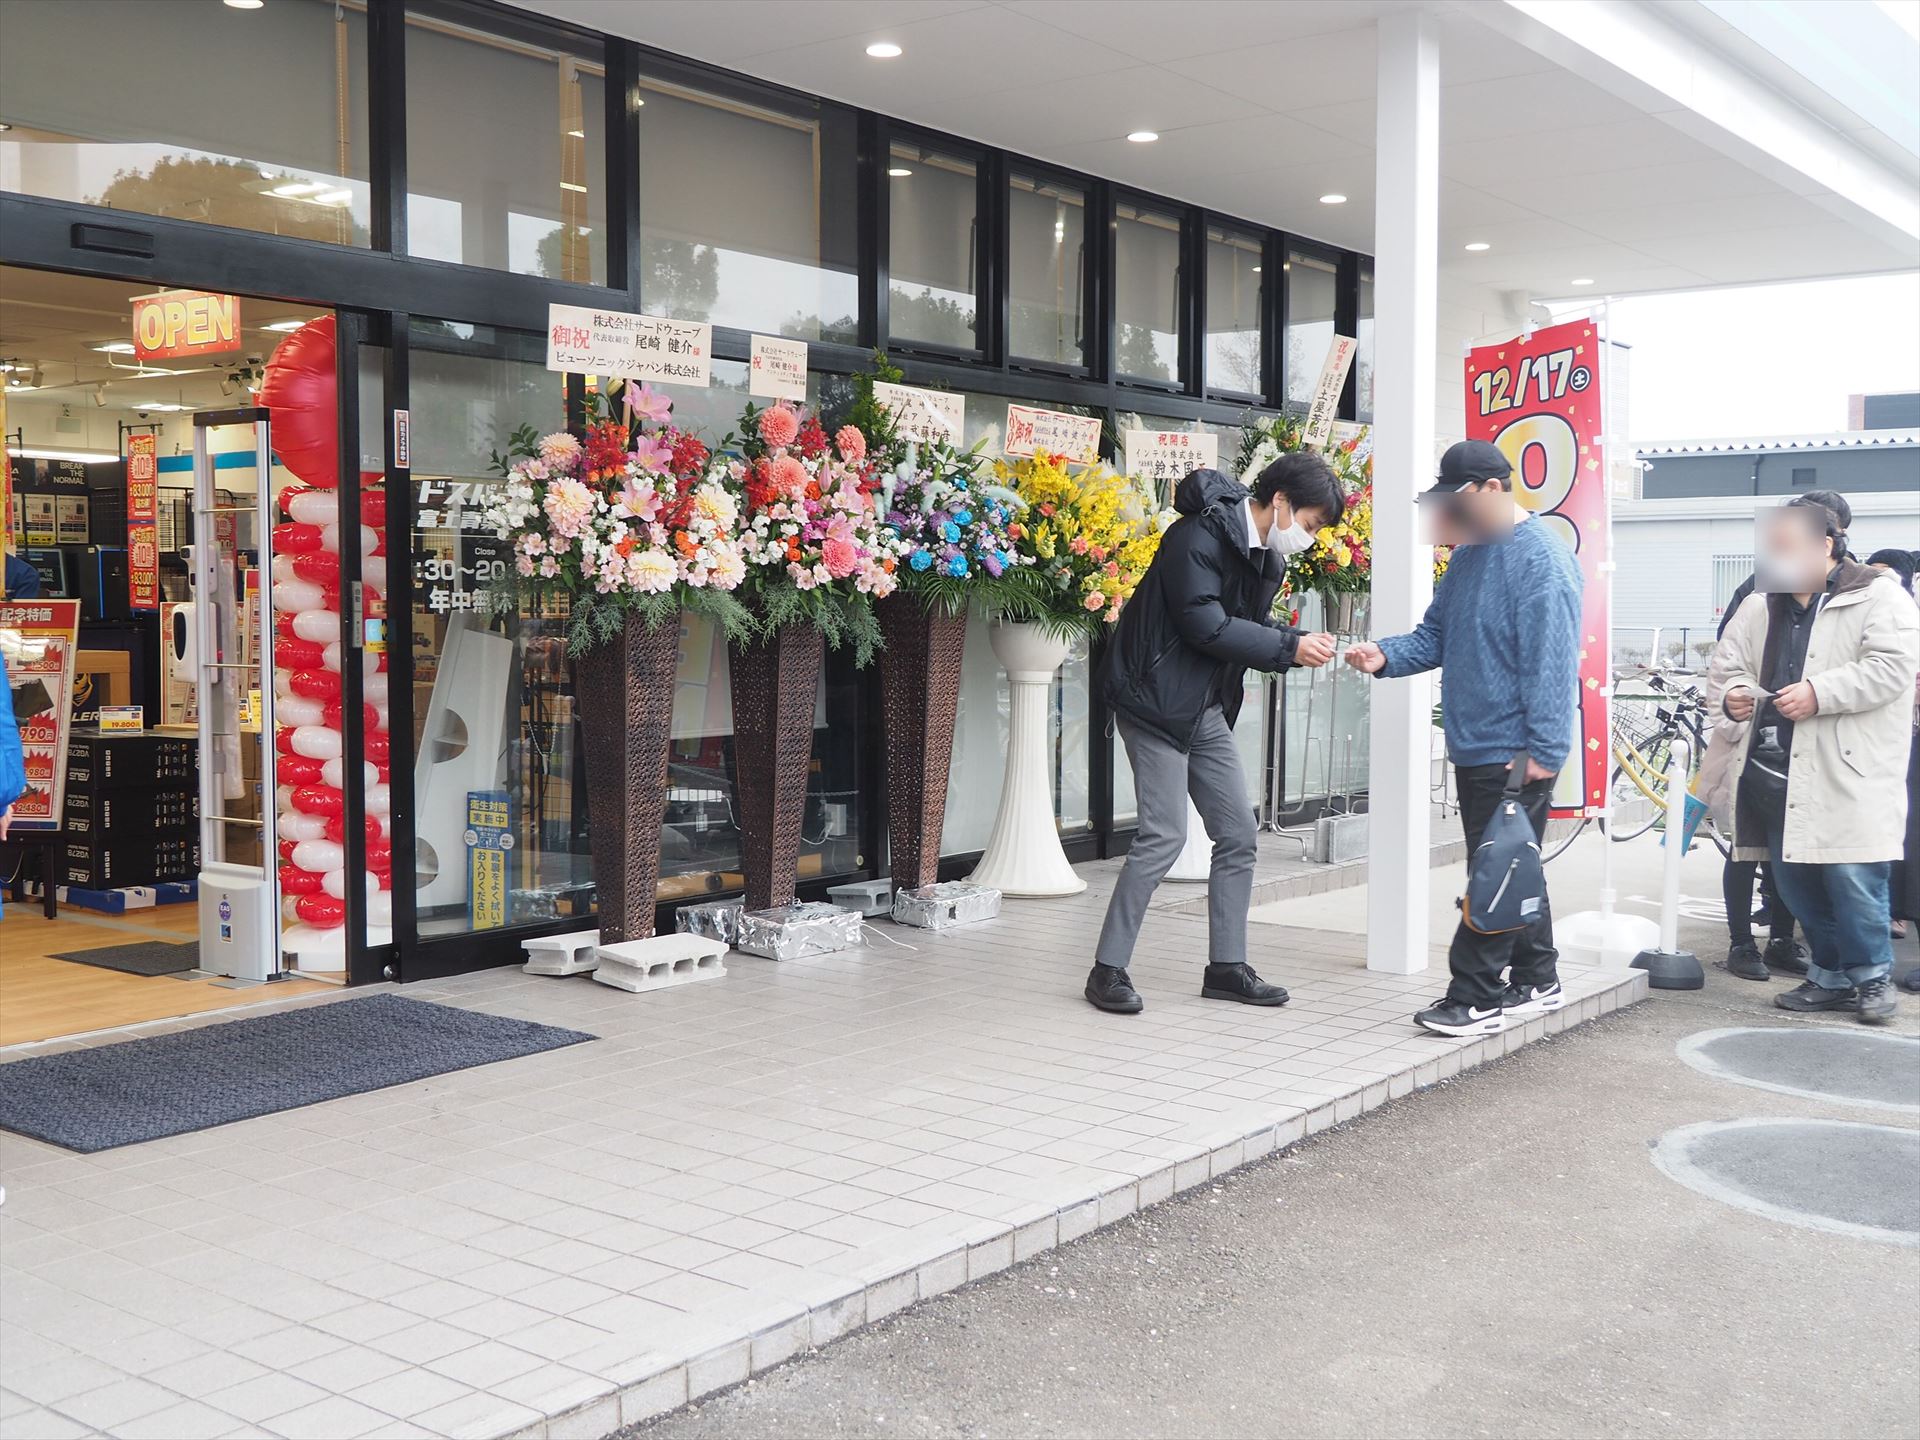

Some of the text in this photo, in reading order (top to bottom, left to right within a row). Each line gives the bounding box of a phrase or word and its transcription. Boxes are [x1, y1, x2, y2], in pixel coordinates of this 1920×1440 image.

[140, 295, 232, 350] OPEN
[594, 314, 701, 338] 株式会社サードウェーブ
[552, 324, 591, 349] 御祝
[635, 334, 661, 351] 尾崎
[556, 351, 701, 378] ビューソニックジャパン株式会社
[753, 355, 761, 369] 祝
[1473, 347, 1575, 416] 12/17
[1158, 433, 1189, 446] 祝開店
[1136, 449, 1203, 460] インテル株式会社
[60, 462, 84, 470] BREAK
[53, 477, 85, 485] NORMAL
[474, 547, 496, 556] Close
[0, 607, 53, 621] 記念特価
[69, 771, 90, 782] ASUS
[473, 812, 505, 825] 実施中
[68, 820, 90, 832] ASUS
[68, 871, 90, 883] ASUS
[476, 850, 487, 921] お入りください
